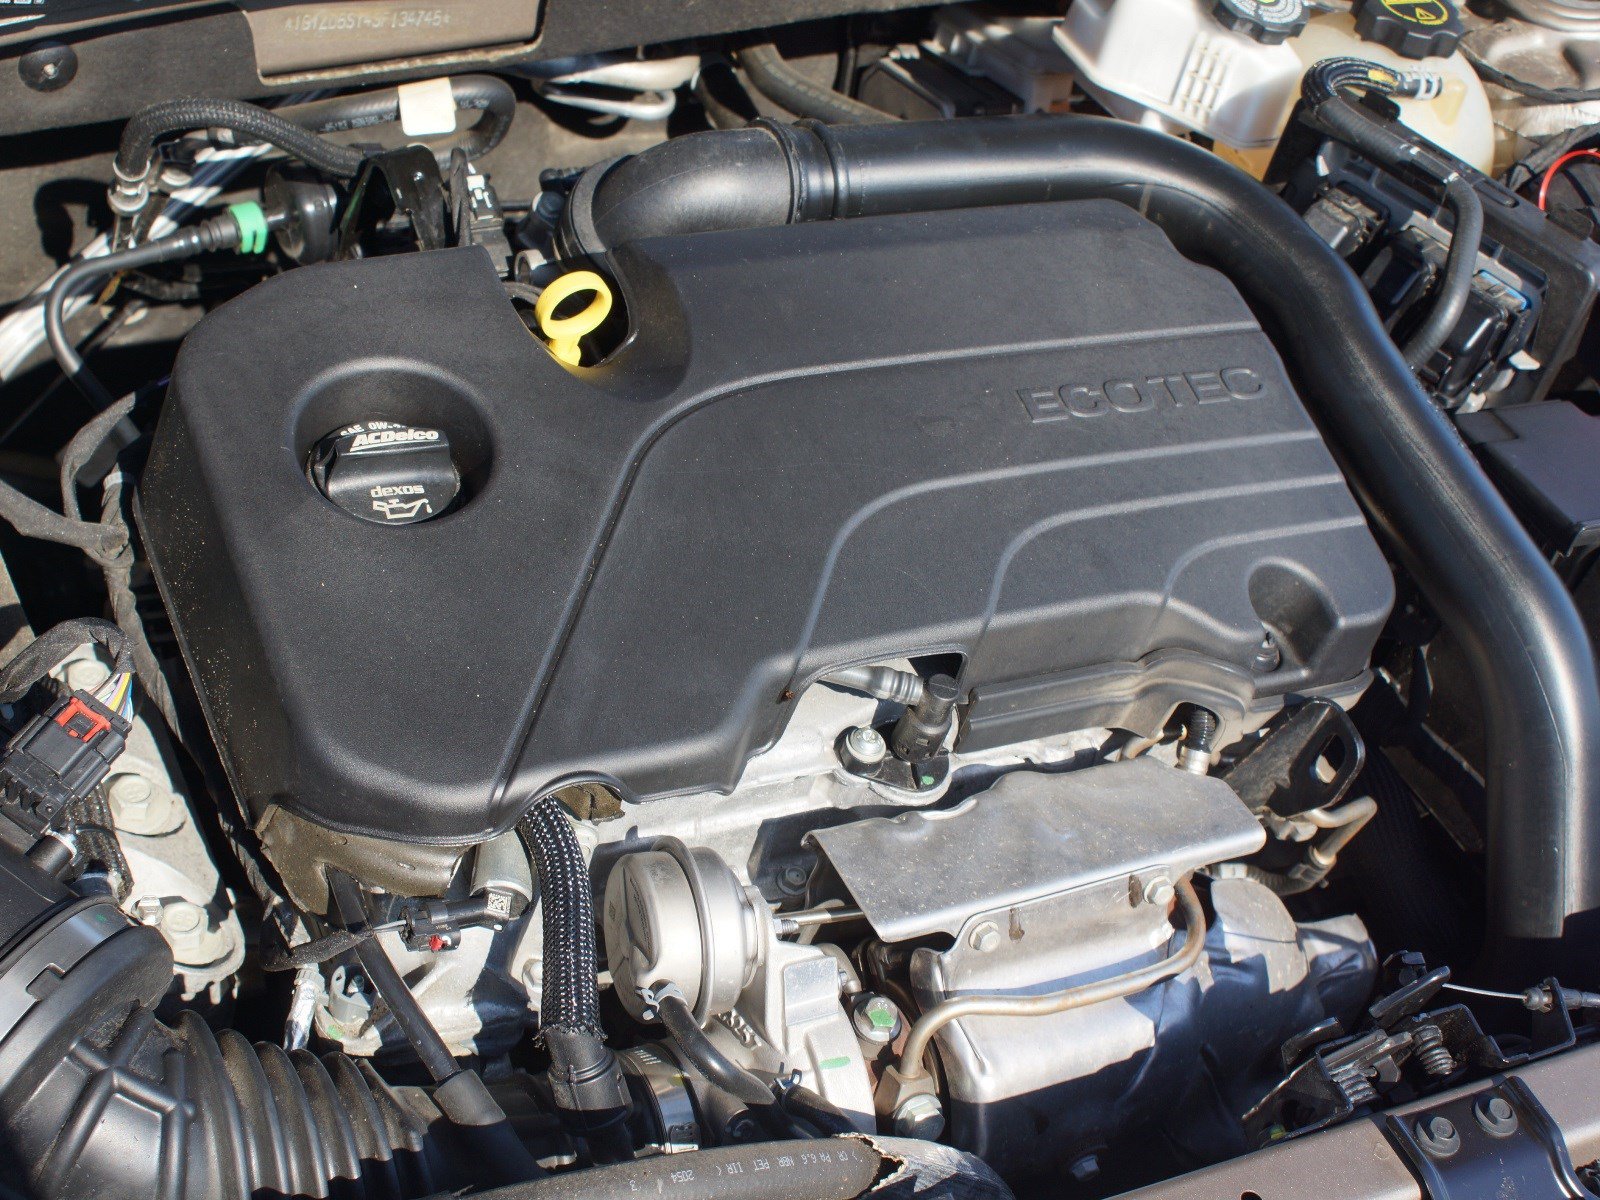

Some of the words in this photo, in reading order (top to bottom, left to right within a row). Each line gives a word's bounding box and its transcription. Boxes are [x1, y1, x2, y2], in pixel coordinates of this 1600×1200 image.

[1016, 367, 1264, 423] ECOTEC
[350, 429, 439, 452] ACDelco
[371, 485, 425, 498] dexos
[753, 1158, 770, 1171] PET
